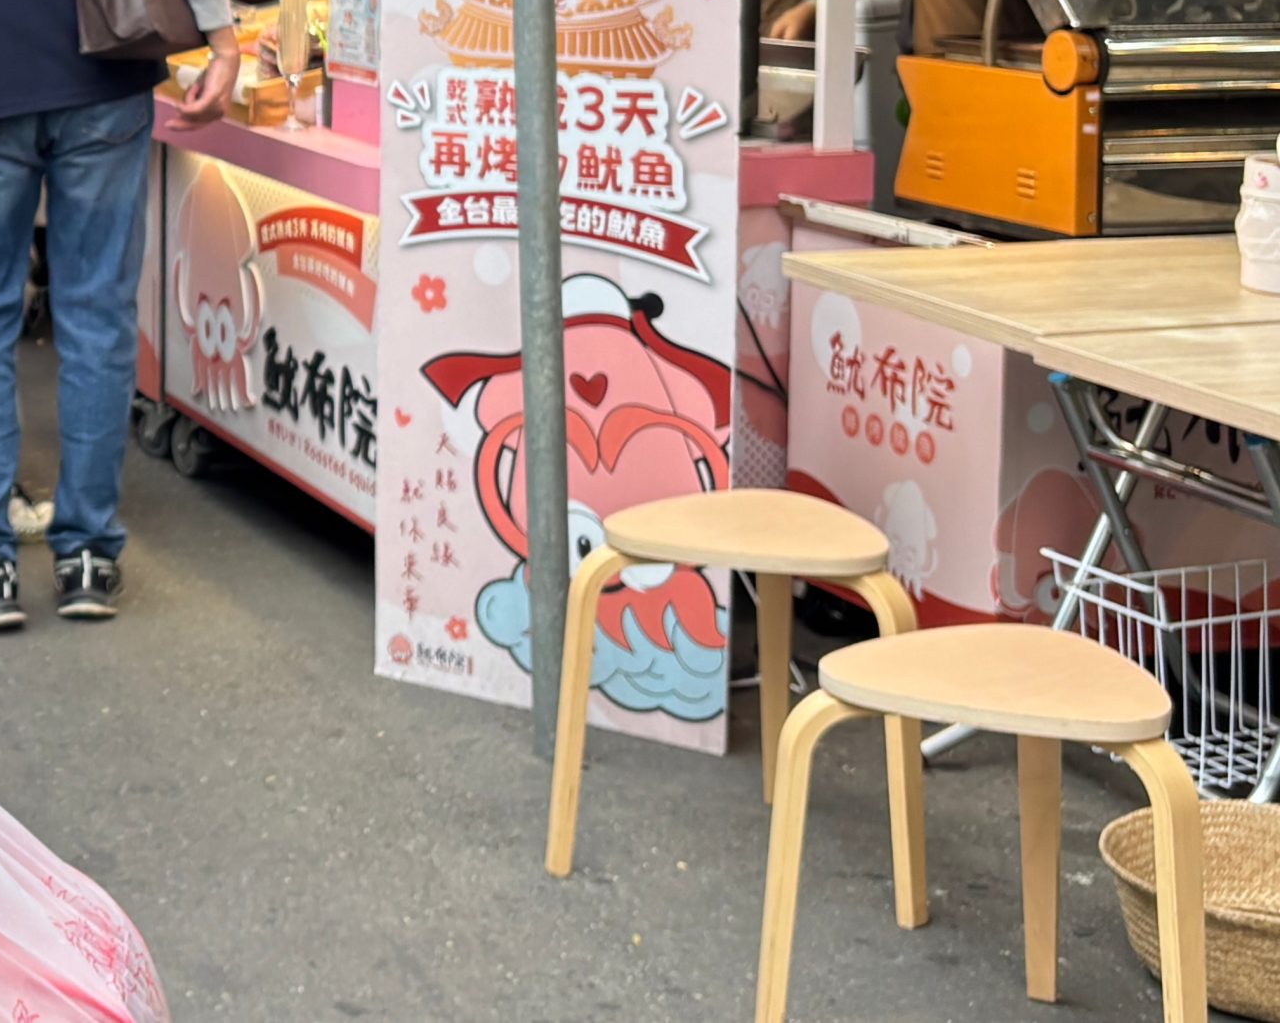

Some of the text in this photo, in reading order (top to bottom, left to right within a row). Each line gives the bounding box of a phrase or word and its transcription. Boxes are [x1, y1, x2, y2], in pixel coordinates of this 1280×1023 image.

[429, 131, 677, 202] 再烤魷魚
[436, 196, 667, 251] 全台最吃的魷魚
[826, 330, 957, 431] 魷布院
[304, 438, 346, 479] Roasted
